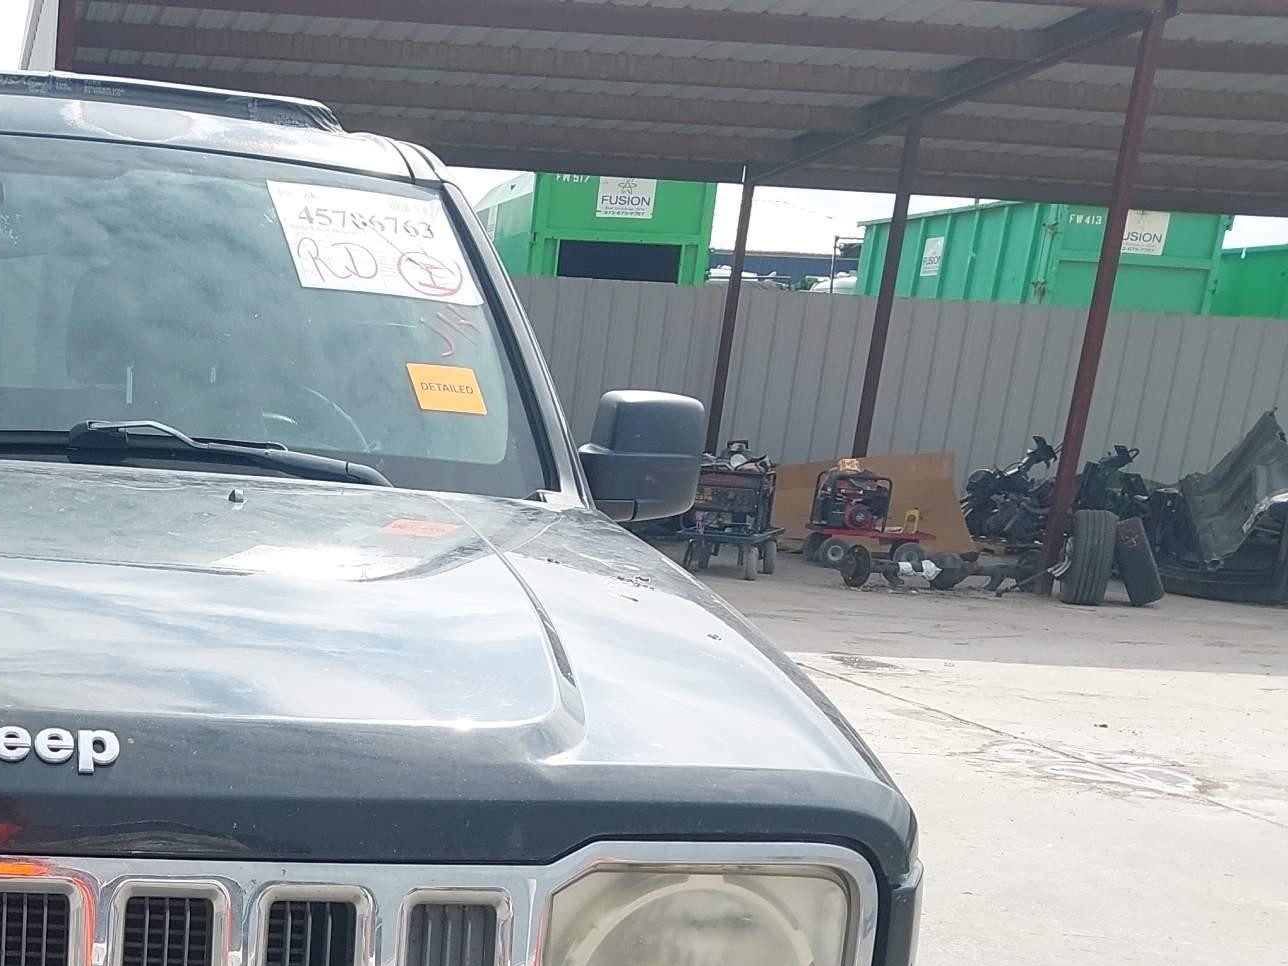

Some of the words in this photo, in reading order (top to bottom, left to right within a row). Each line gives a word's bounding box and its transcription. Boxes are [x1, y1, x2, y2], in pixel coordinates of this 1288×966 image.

[601, 195, 651, 207] FUSION
[1069, 213, 1103, 225] FW413
[1122, 231, 1163, 244] USION
[420, 381, 474, 395] DETAILED
